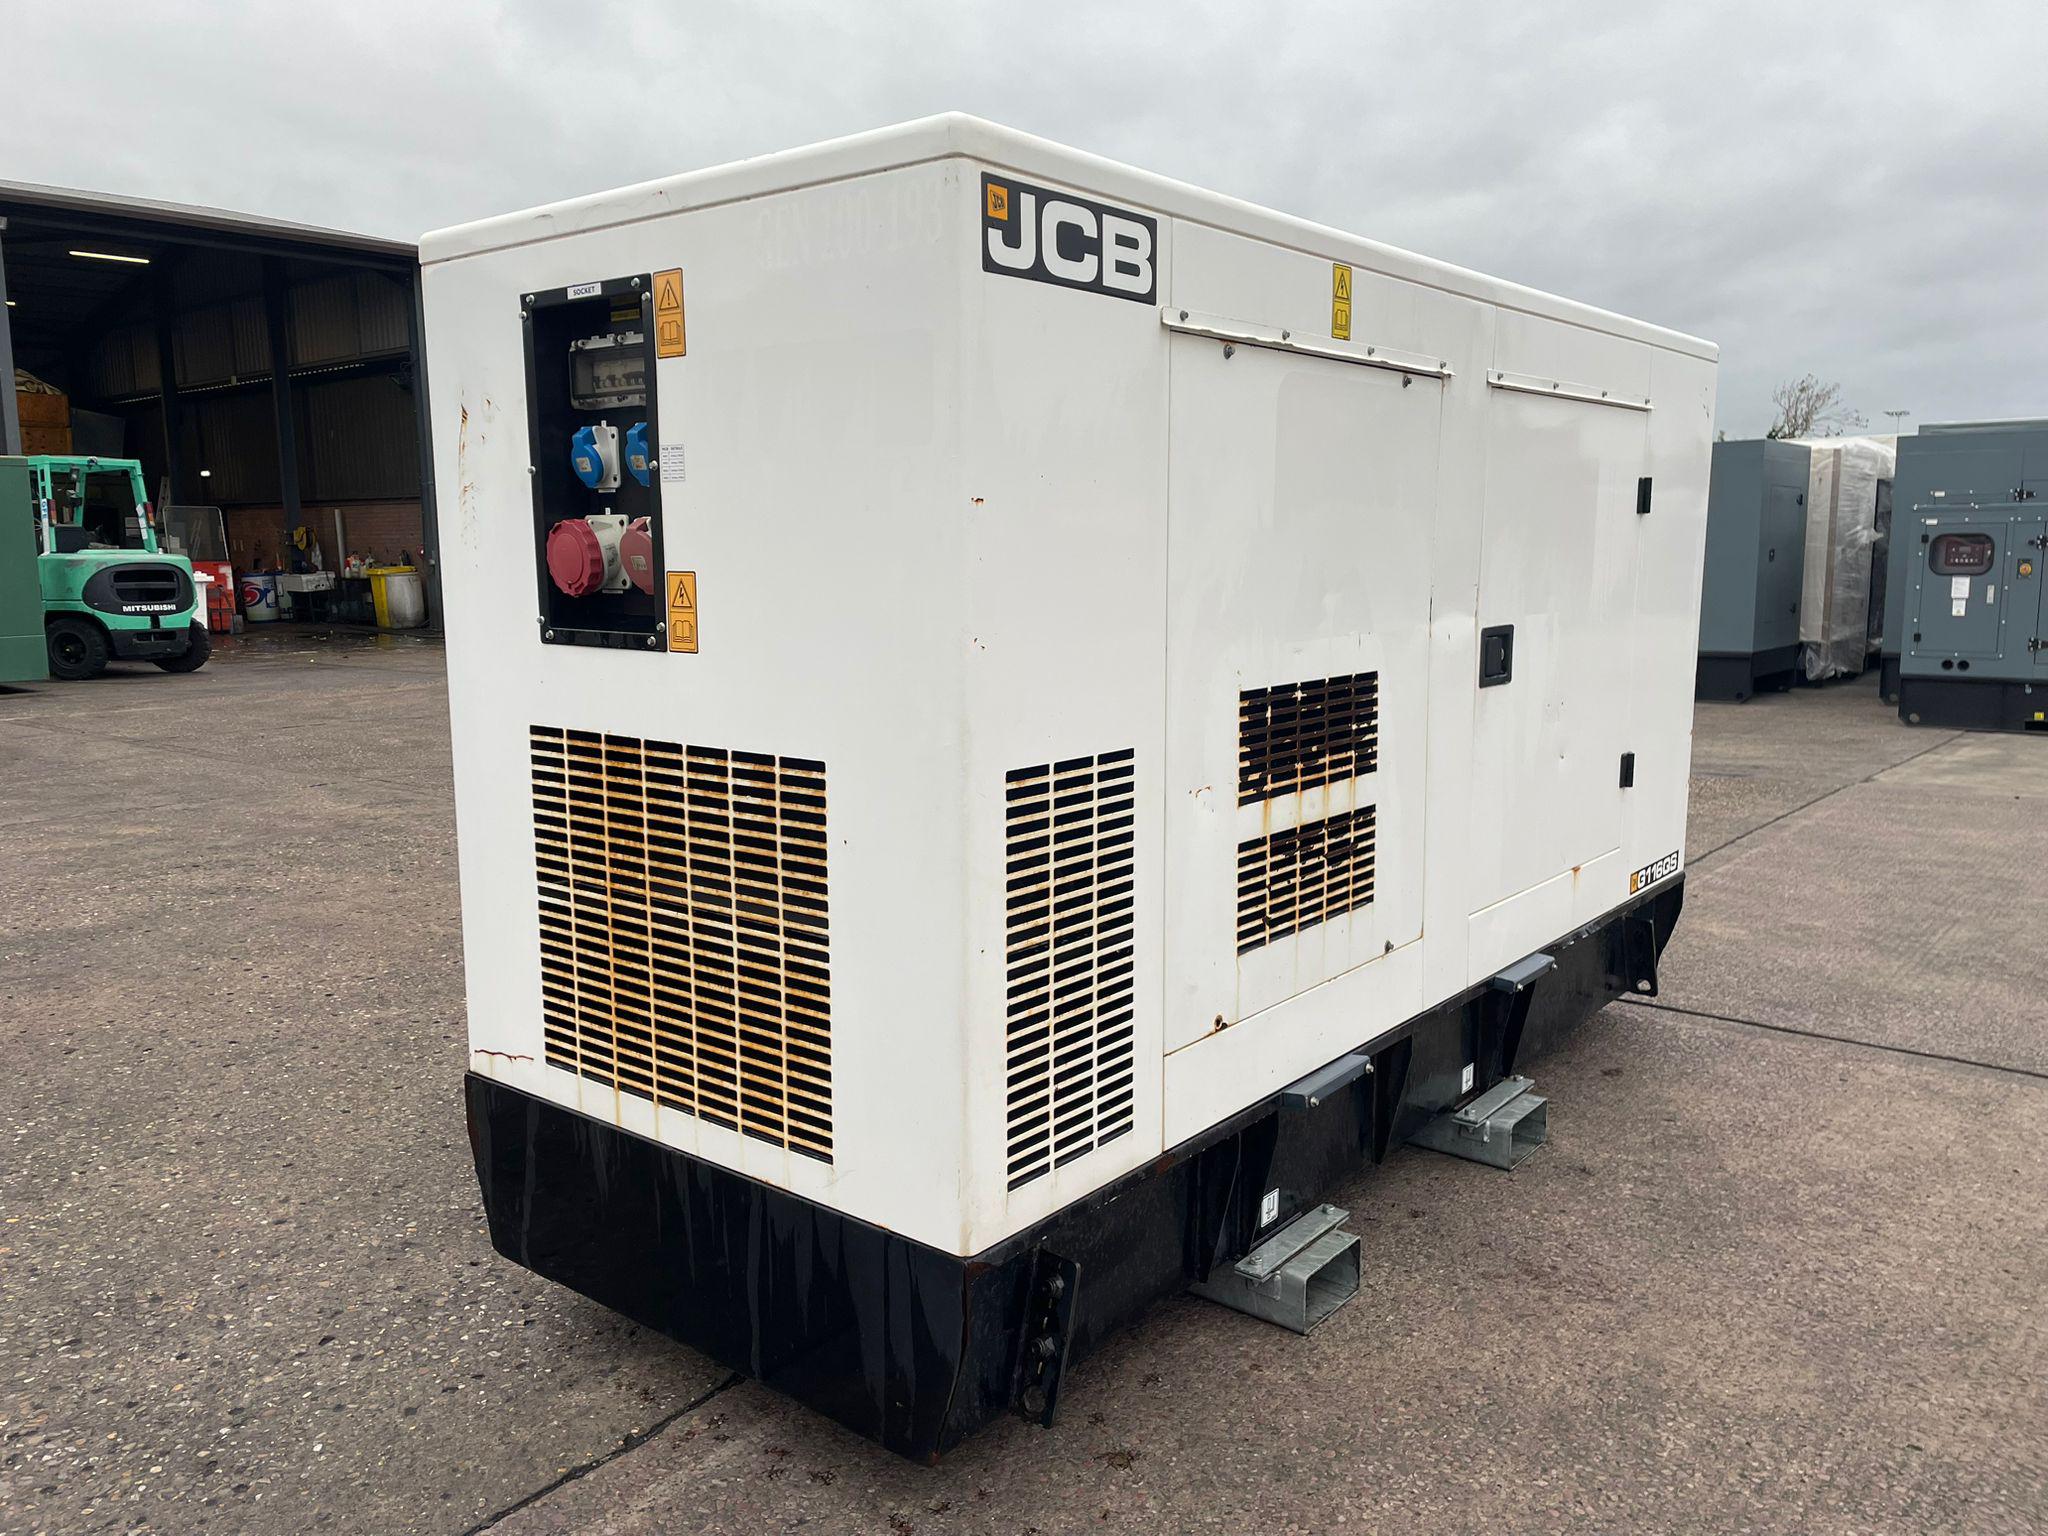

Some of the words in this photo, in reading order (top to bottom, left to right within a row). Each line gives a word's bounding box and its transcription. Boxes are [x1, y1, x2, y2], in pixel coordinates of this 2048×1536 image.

[987, 192, 1153, 295] JCB
[573, 286, 595, 296] SOCKET
[122, 604, 177, 612] MITSUBISHI
